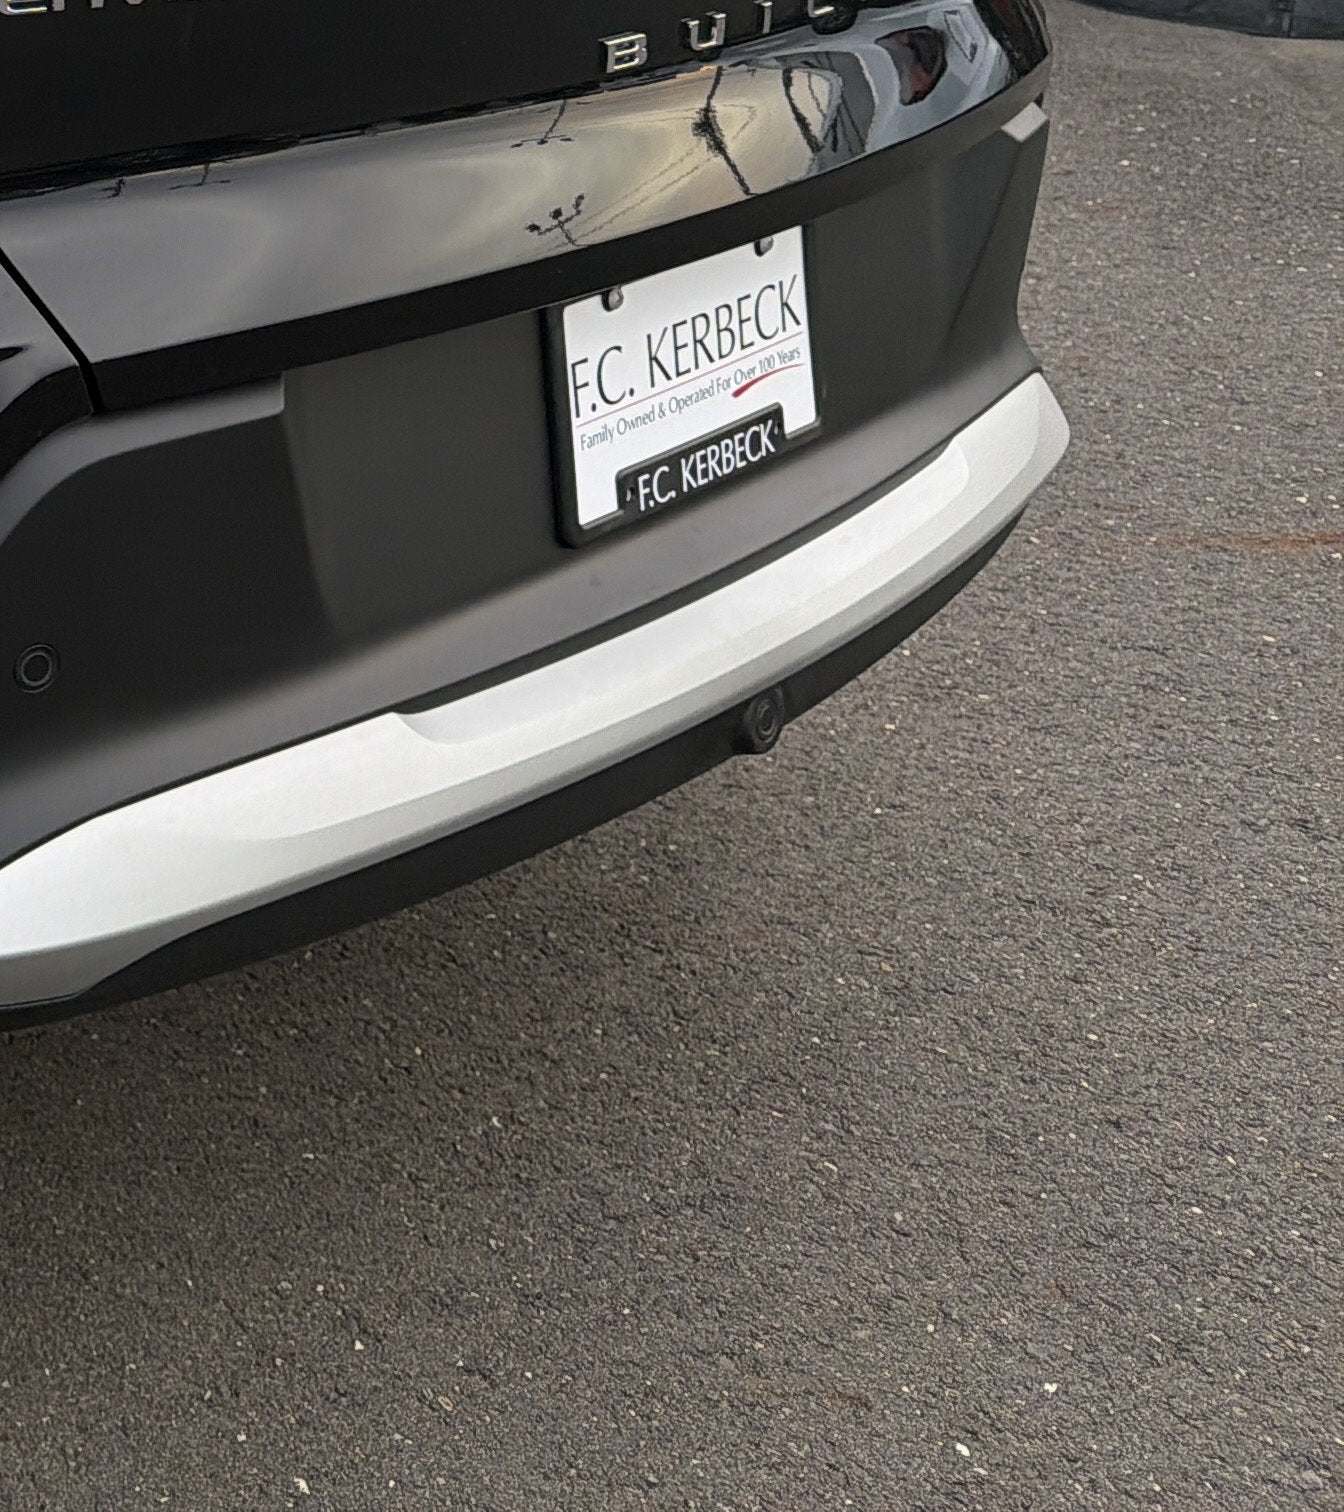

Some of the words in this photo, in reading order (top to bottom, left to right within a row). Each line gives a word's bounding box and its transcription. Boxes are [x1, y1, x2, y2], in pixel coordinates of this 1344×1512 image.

[570, 345, 635, 419] F.C.
[646, 273, 802, 389] KERBECK
[580, 423, 614, 451] Family
[616, 403, 656, 435] Owned
[657, 402, 667, 419] &
[668, 379, 715, 414] Operated
[716, 376, 732, 394] For
[733, 366, 757, 385] Over
[758, 354, 776, 374] 100
[776, 347, 801, 365] Years
[637, 465, 677, 512] F.C.
[680, 418, 776, 493] KERBECK
